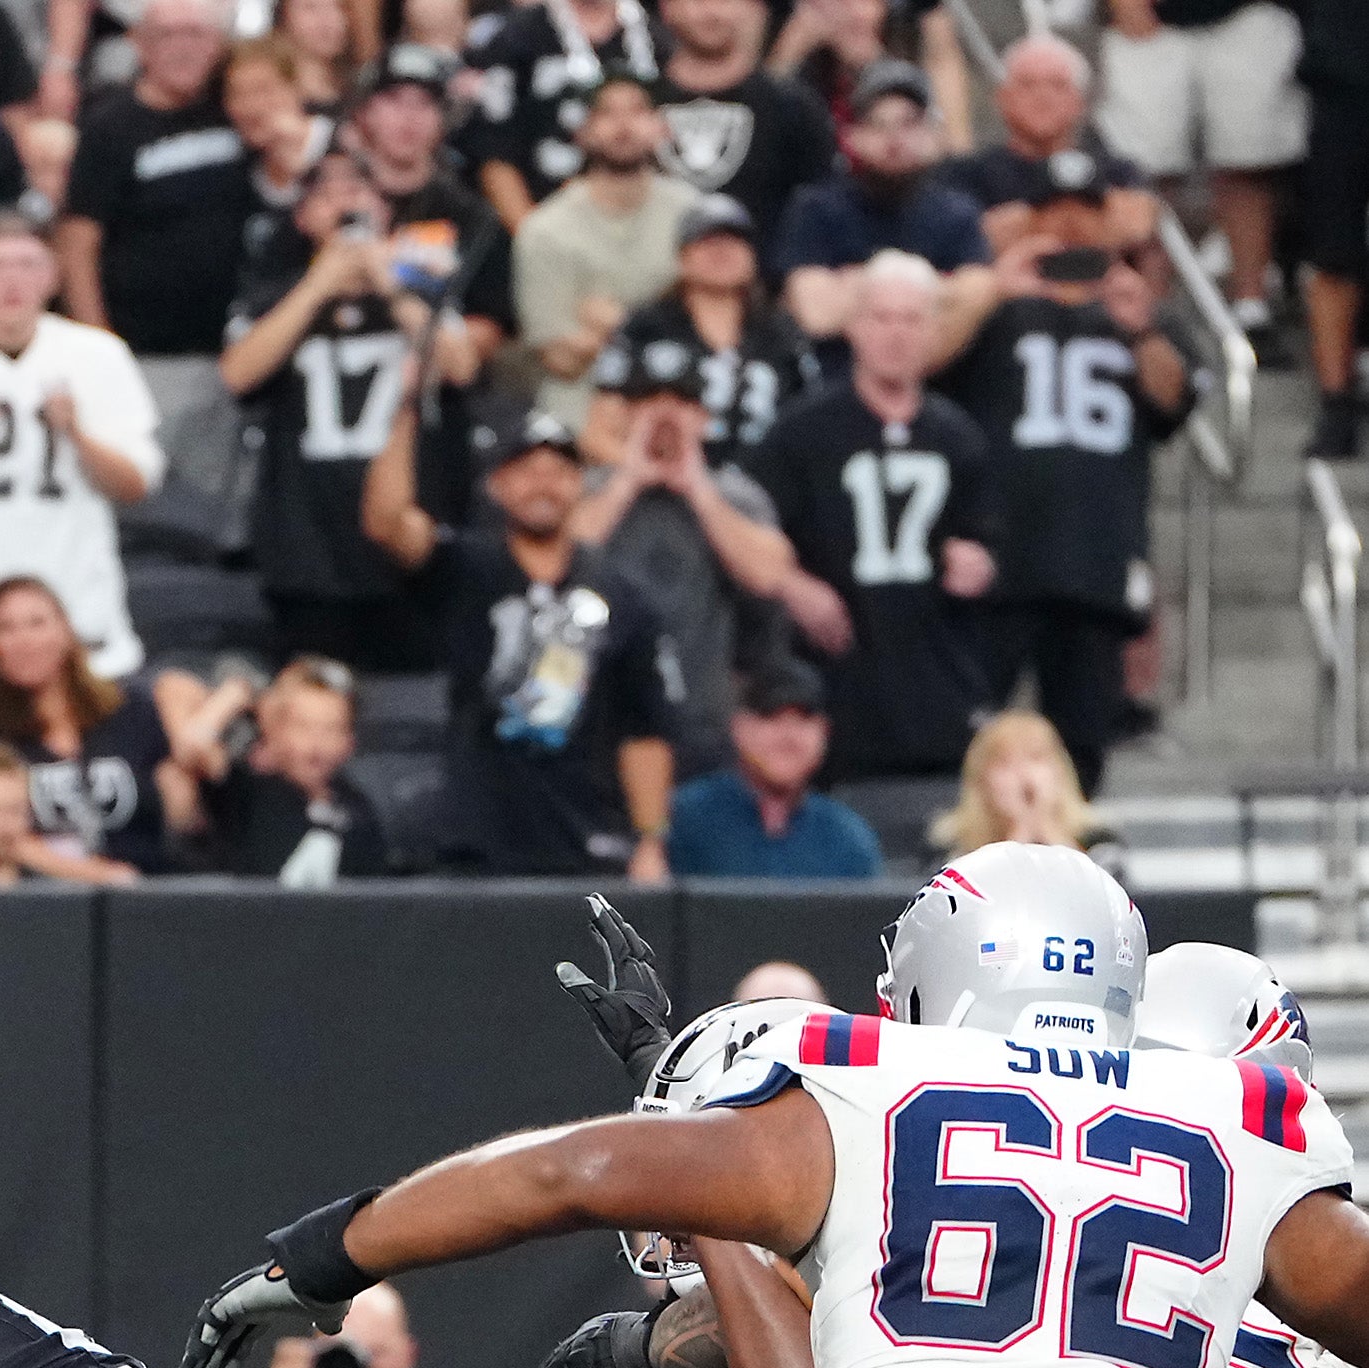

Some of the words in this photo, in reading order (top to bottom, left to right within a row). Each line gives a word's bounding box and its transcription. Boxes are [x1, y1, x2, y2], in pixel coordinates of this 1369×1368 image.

[293, 333, 409, 461] 17
[1012, 331, 1137, 455] 16
[842, 451, 952, 587] 17
[1043, 936, 1095, 976] 62
[1034, 1013, 1095, 1035] PATRIOTS
